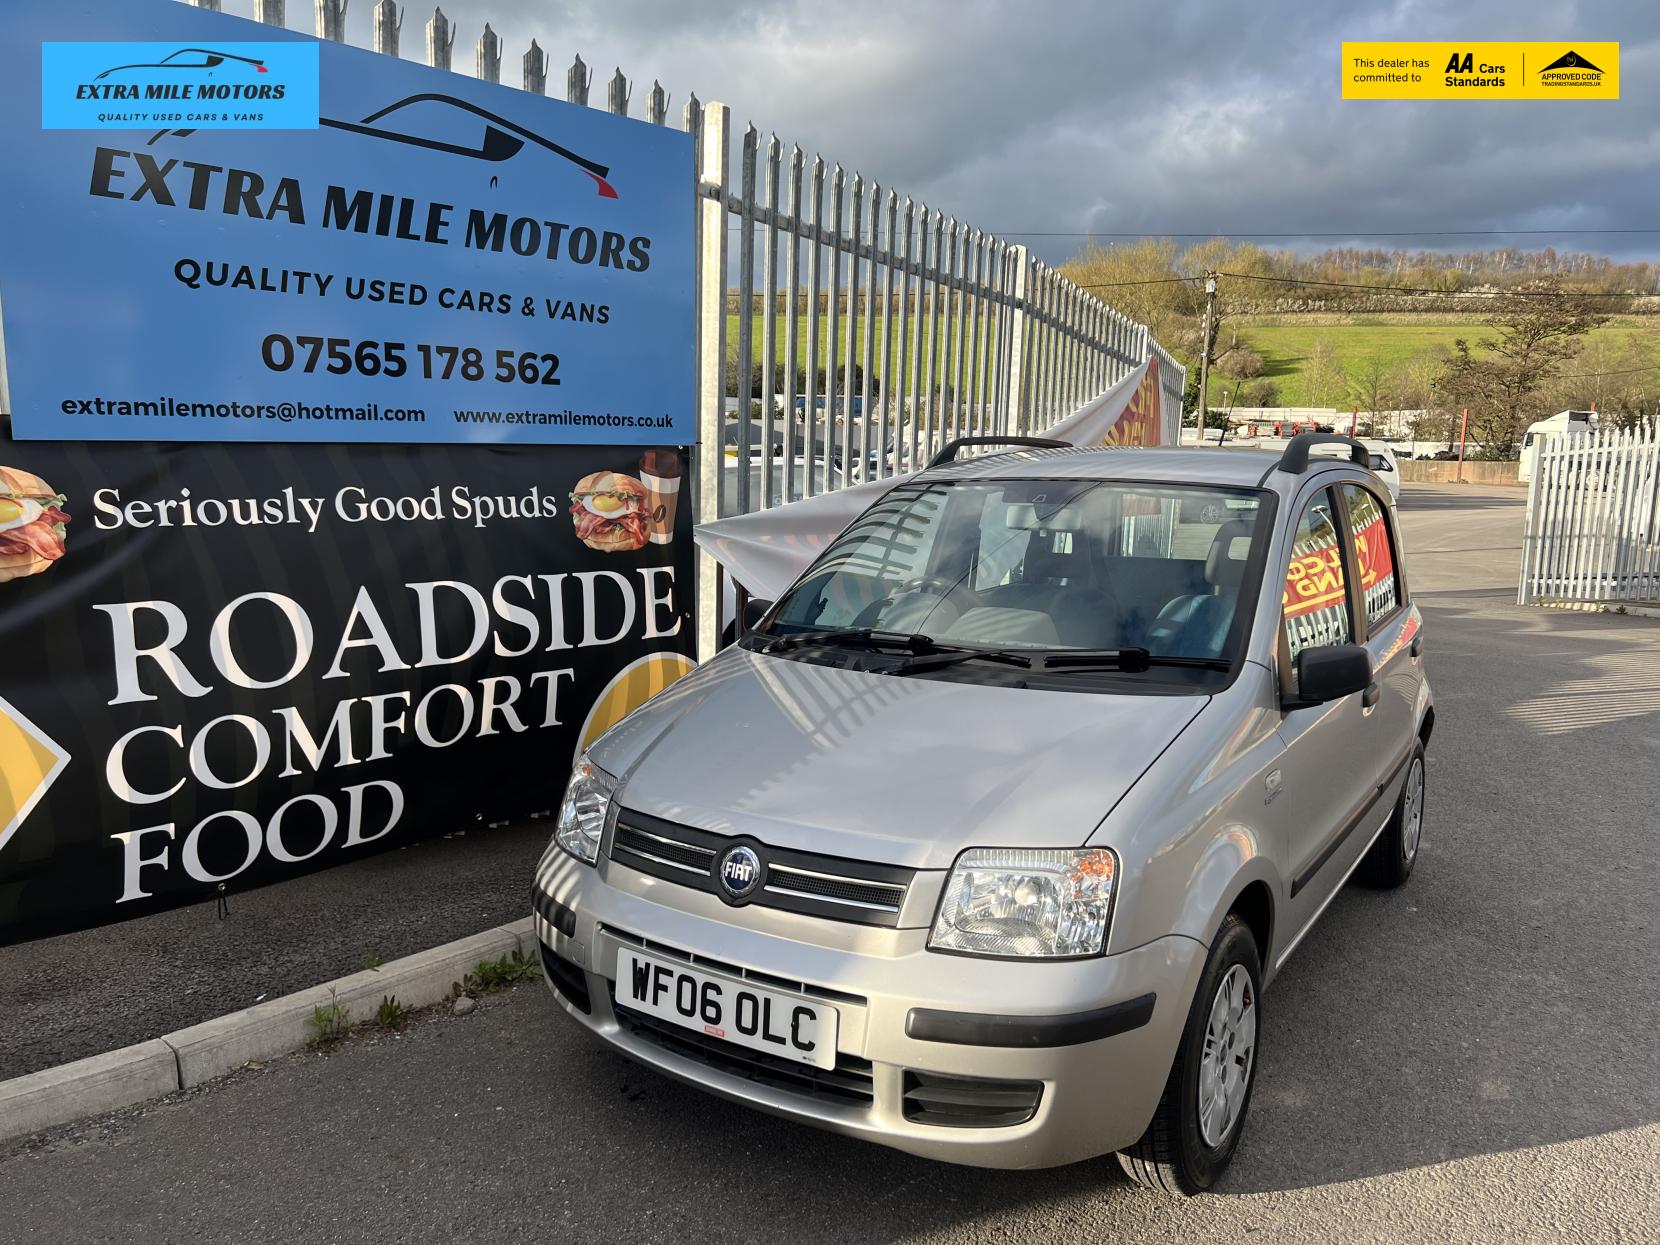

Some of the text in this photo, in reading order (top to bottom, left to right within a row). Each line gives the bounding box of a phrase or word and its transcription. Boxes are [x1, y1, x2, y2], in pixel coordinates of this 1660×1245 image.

[90, 147, 650, 272] EXTRA MILE MOTORS
[175, 259, 609, 324] QUALITY USED CARS & VANS
[262, 334, 560, 385] 07565 178 562
[62, 397, 425, 422] extramilemotors@hotmail.com
[454, 410, 673, 427] www.extramilemotors.co.uk
[94, 486, 556, 532] Seriously Good Spuds
[93, 566, 681, 705] ROADSIDE
[106, 668, 574, 804] COMFORT
[111, 781, 403, 903] FOOD
[723, 863, 753, 882] FIAT
[632, 957, 817, 1052] WF06 OLC
